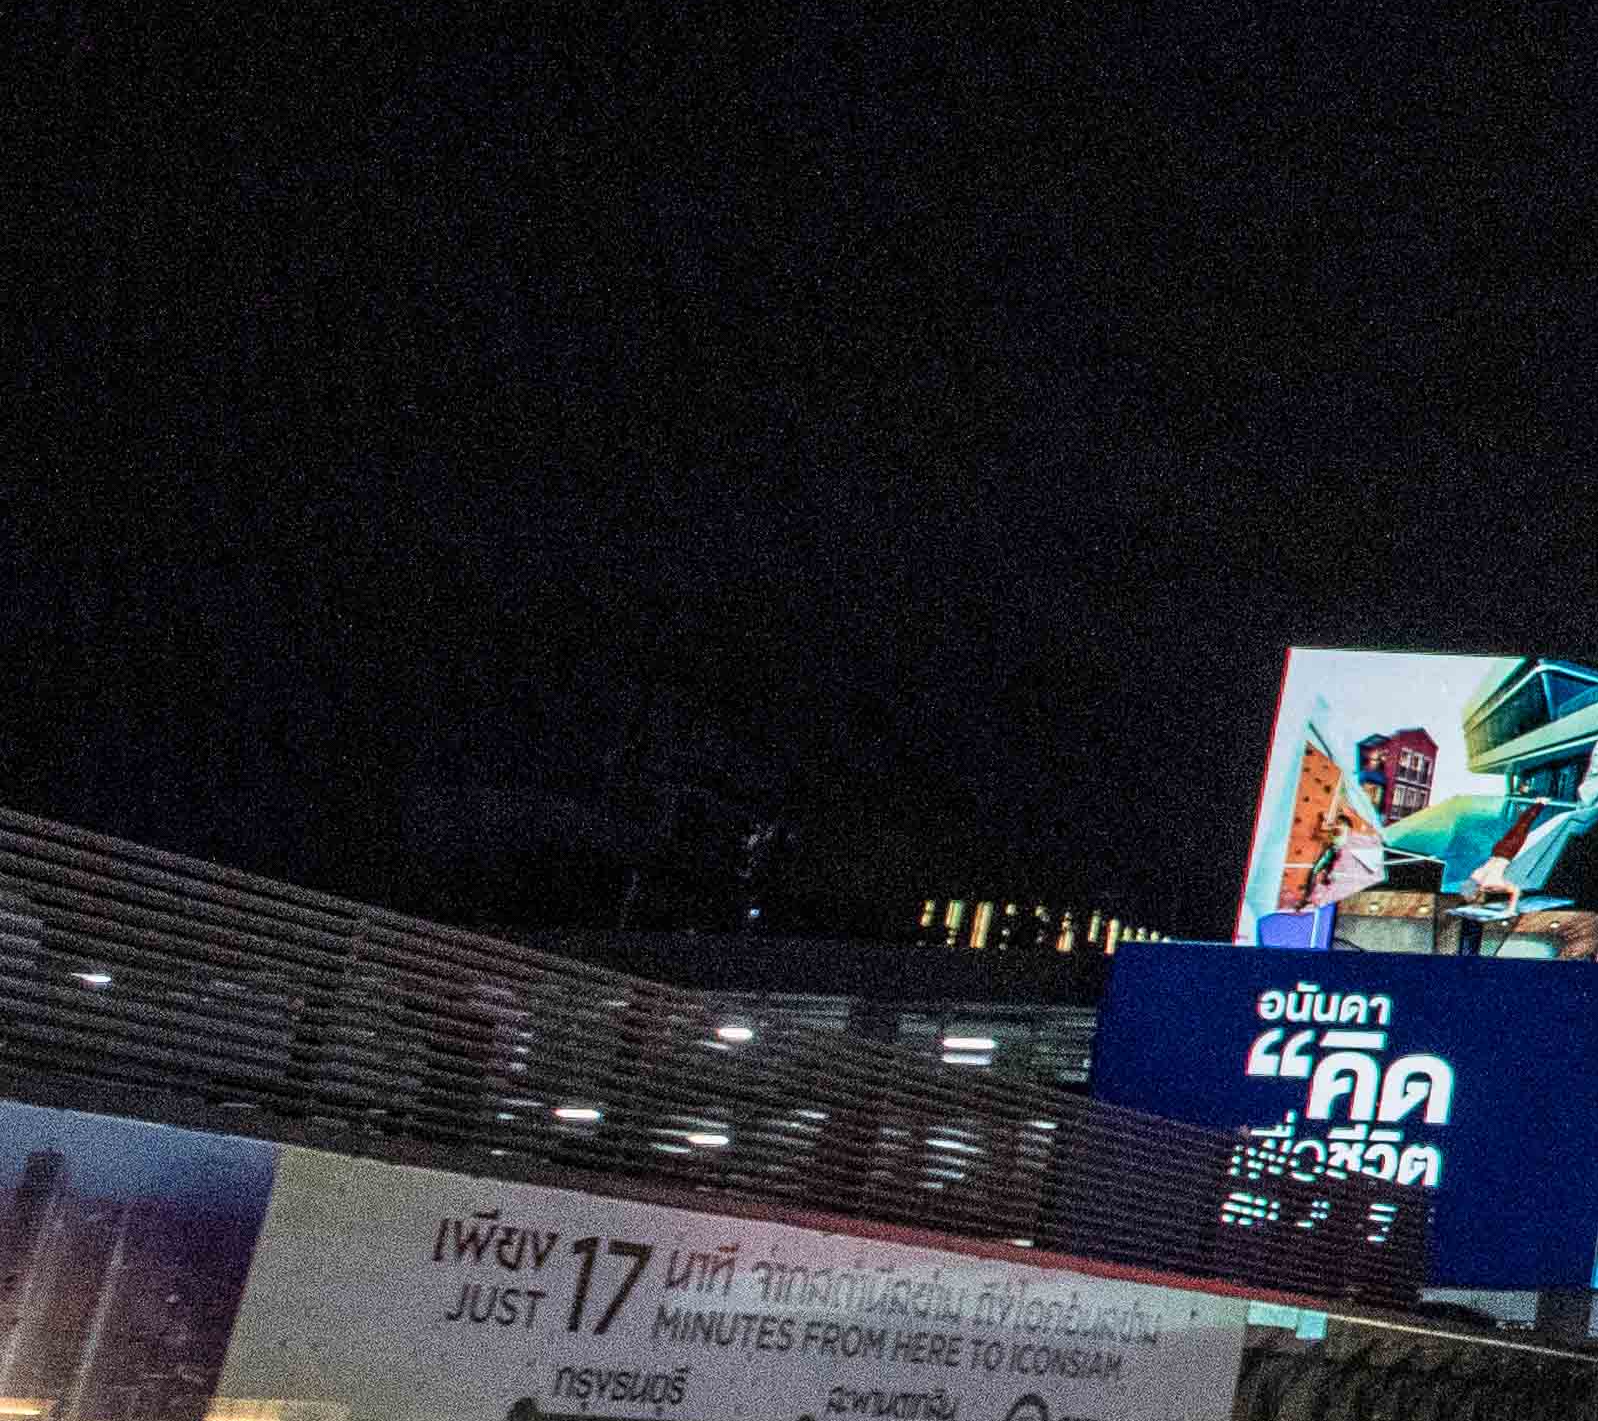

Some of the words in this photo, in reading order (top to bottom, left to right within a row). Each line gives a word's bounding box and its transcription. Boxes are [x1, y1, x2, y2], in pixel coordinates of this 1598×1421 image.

[1257, 980, 1392, 1025] อนันดา
[445, 1283, 548, 1328] JUST
[649, 1304, 795, 1353] MINUTES
[801, 1318, 885, 1360] FROM
[891, 1328, 964, 1368] HERE
[970, 1338, 1006, 1371] TO
[1008, 1341, 1126, 1380] ICONSIAM
[566, 1234, 656, 1336] 17
